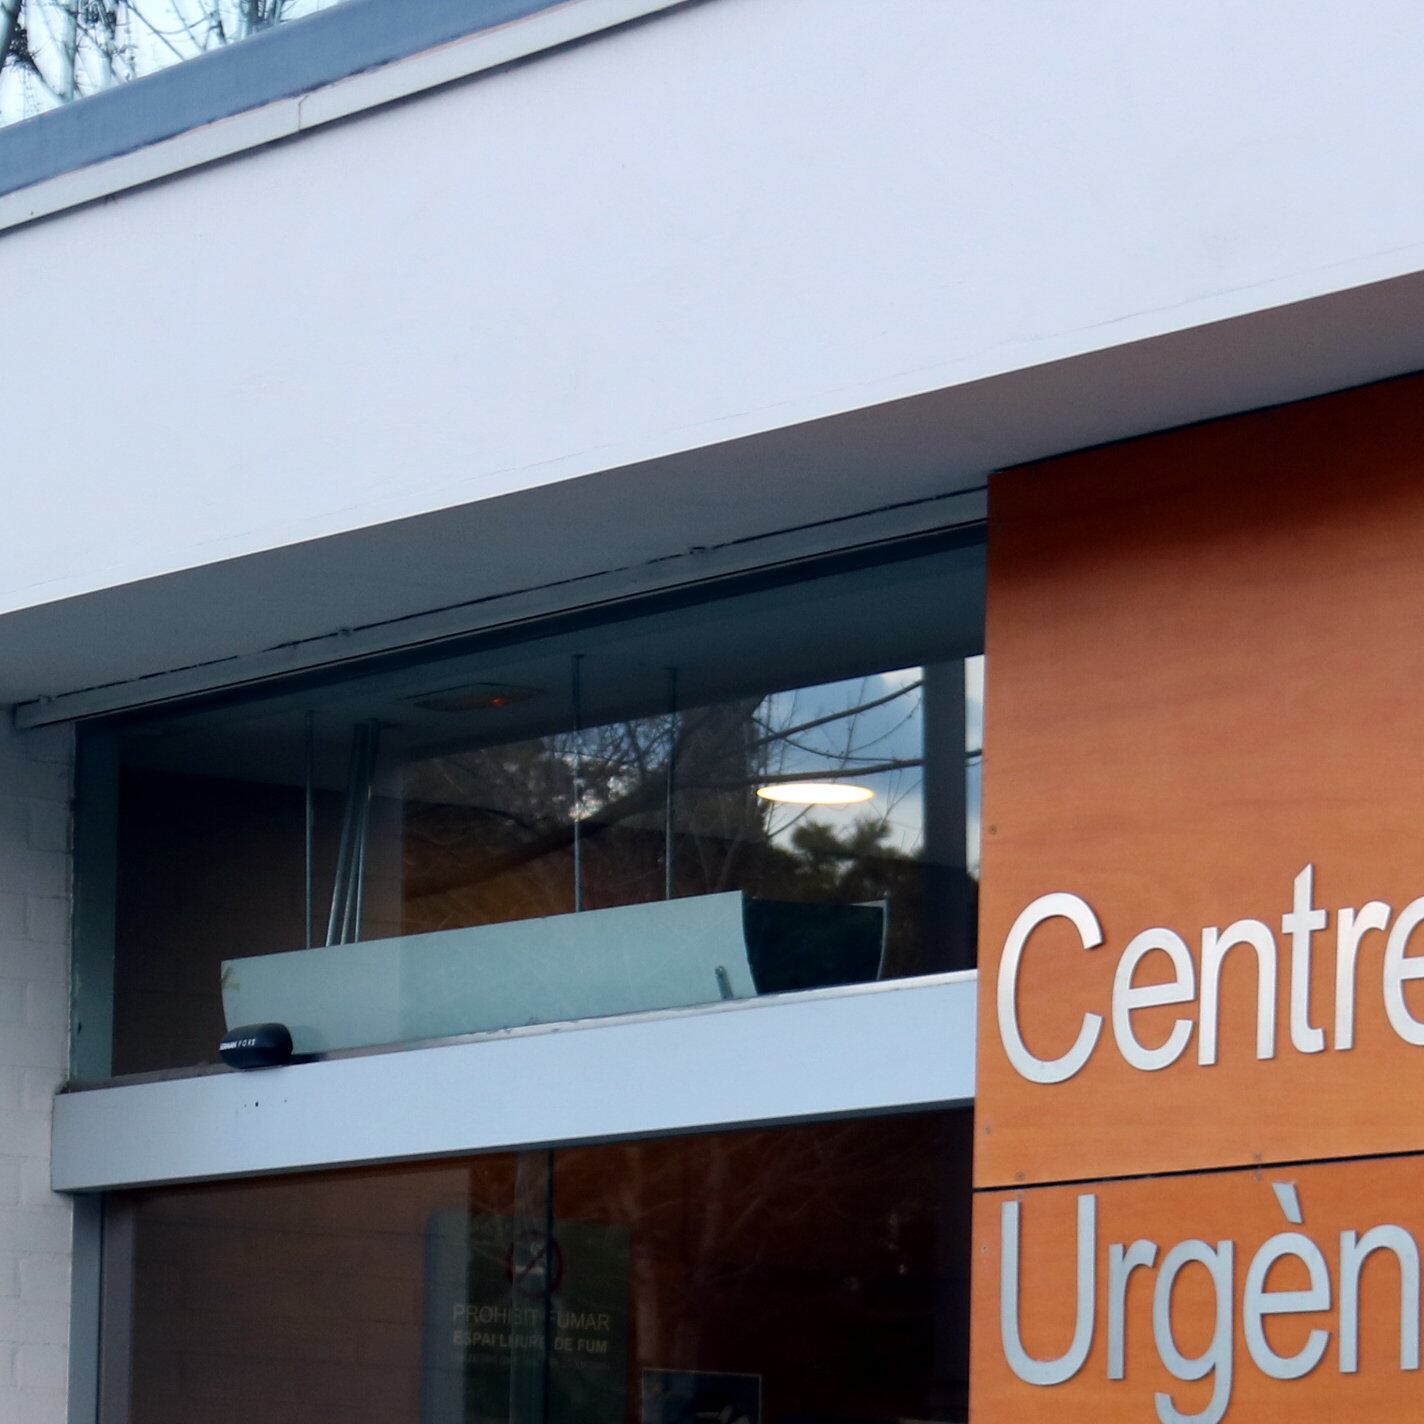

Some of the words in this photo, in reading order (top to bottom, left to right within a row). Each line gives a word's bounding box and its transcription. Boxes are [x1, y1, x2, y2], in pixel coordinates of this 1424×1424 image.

[452, 1303, 539, 1327] PROHIBIT
[554, 1336, 573, 1352] DE
[577, 1338, 608, 1353] FUM
